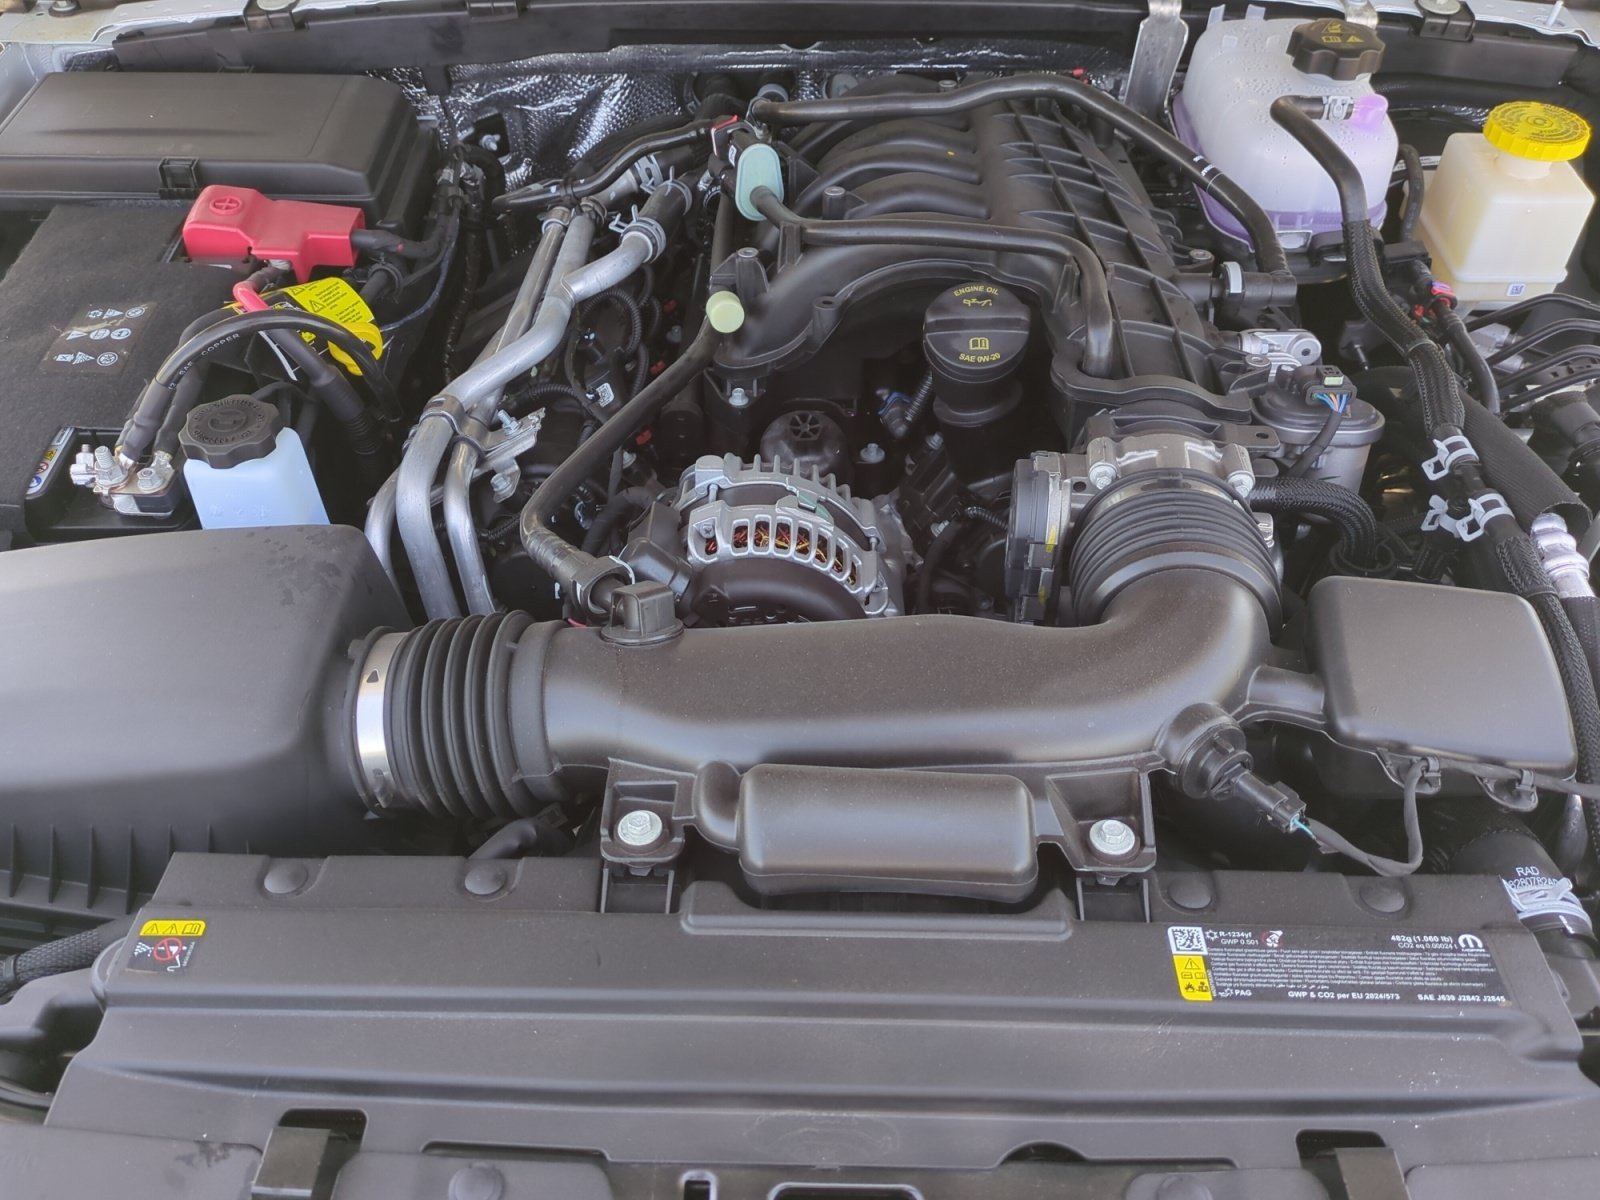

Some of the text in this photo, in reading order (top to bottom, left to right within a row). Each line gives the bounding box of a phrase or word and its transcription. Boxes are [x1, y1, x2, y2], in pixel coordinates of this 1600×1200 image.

[953, 285, 1001, 297] ENGINE OIL
[200, 333, 240, 356] COPPER
[958, 352, 1001, 363] SAE 0W-20
[1515, 866, 1540, 877] RAD
[1235, 989, 1252, 997] PAG
[1288, 990, 1308, 998] GWP
[1317, 991, 1335, 999] CO2
[1417, 993, 1435, 1001] SAE
